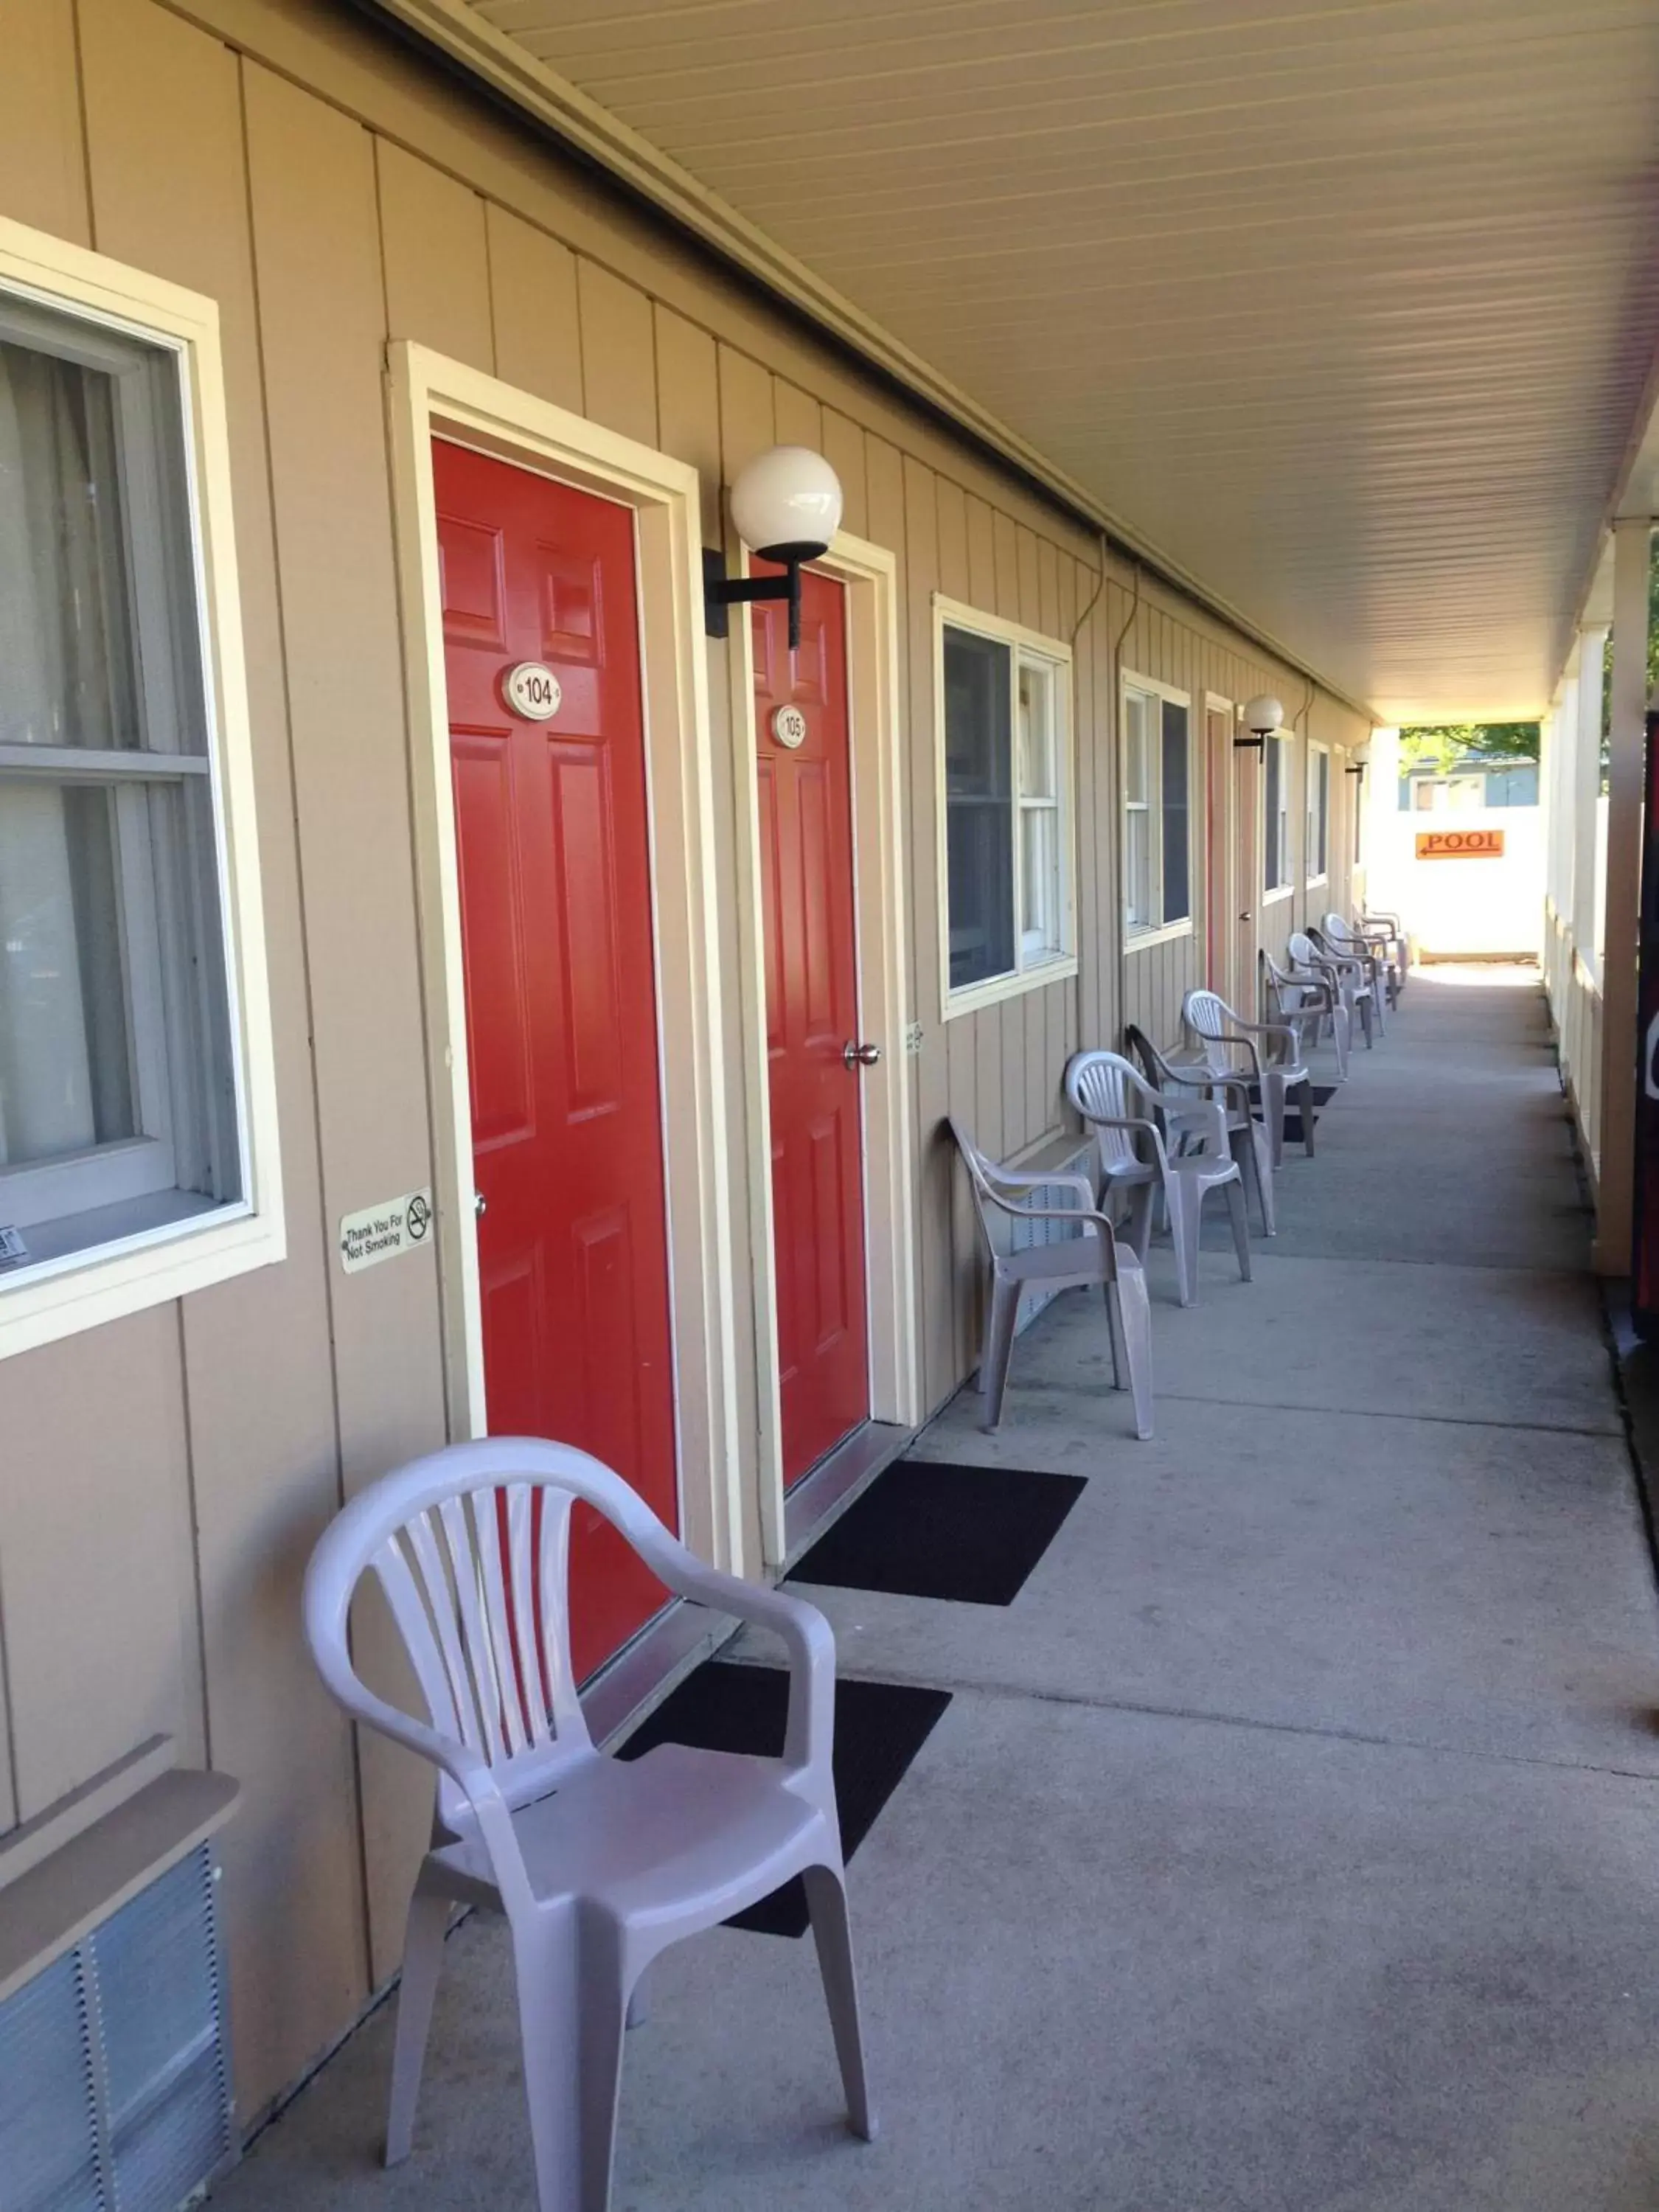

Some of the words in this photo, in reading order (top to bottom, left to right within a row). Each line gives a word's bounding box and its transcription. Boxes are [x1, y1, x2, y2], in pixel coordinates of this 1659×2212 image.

[525, 676, 552, 705] 104
[786, 716, 801, 736] 105
[1427, 832, 1500, 849] POOL
[347, 1223, 372, 1243] Thank
[373, 1219, 389, 1233] You
[389, 1214, 403, 1228] For
[346, 1245, 364, 1261] Not
[365, 1232, 400, 1255] Smoking
